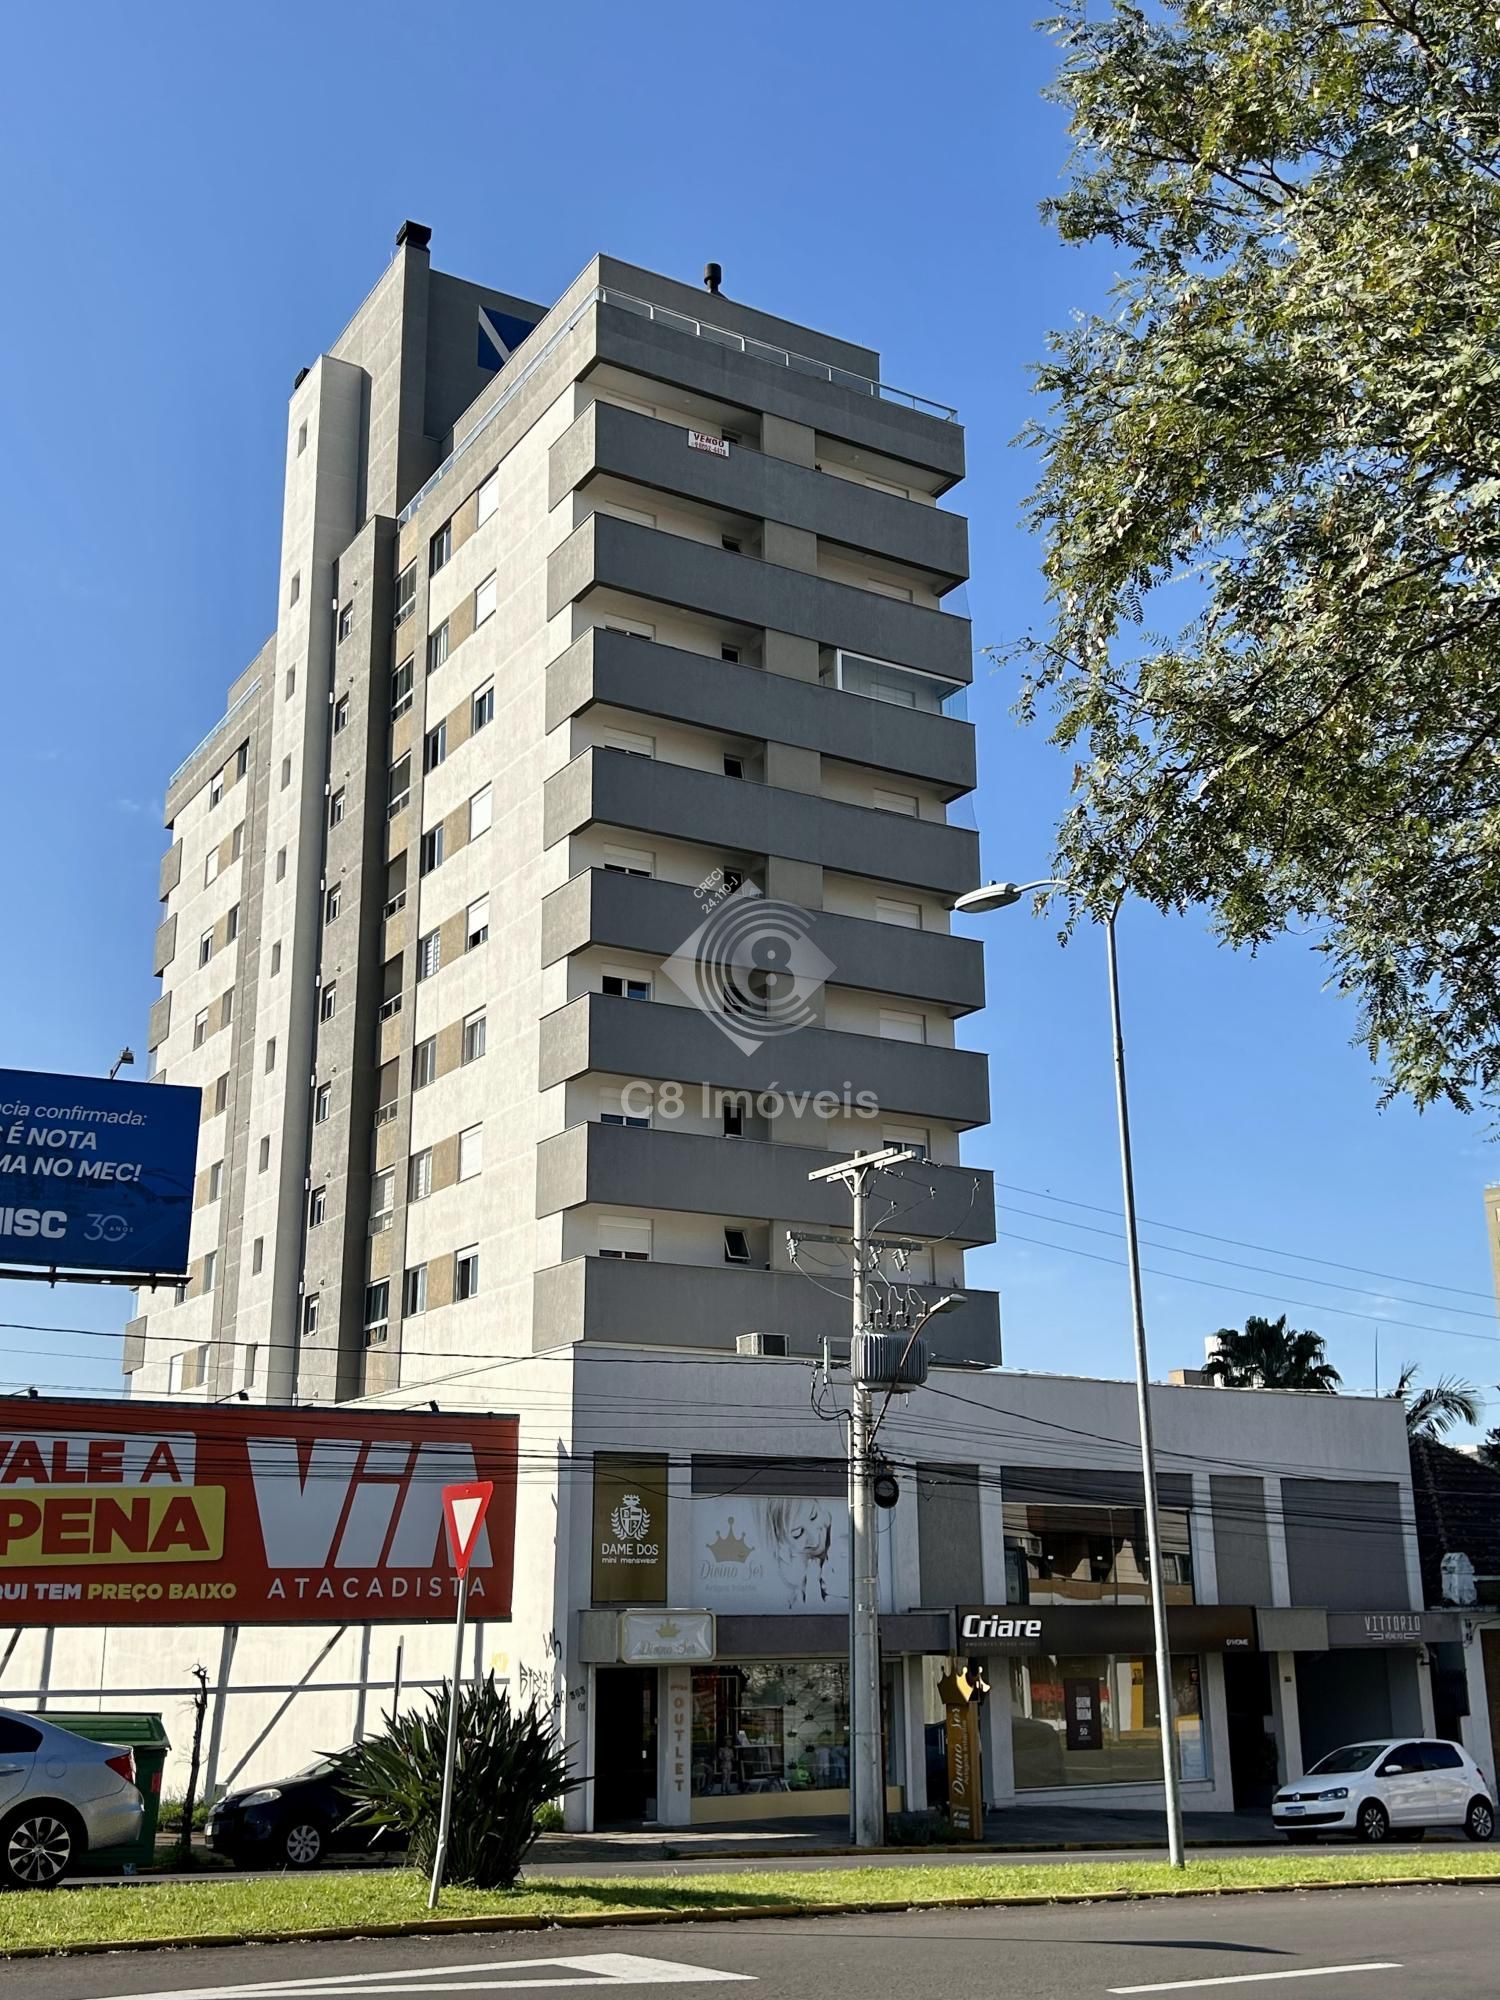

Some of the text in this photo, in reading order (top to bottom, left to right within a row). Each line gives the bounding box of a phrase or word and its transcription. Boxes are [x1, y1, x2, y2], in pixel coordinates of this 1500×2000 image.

[693, 432, 725, 447] VENDO
[0, 1100, 147, 1126] cia confirmada:
[7, 1120, 97, 1150] É NOTA
[32, 1157, 73, 1177] NO
[77, 1160, 142, 1182] MEC!
[0, 1207, 68, 1239] ISC
[140, 1440, 182, 1483] A
[0, 1496, 211, 1556] PENA
[601, 1543, 659, 1555] DAME DOS
[601, 1556, 659, 1565] mini menswear
[0, 1583, 237, 1604] UI TEM PREÇO BAIXO
[267, 1576, 486, 1599] ATACADISTA
[962, 1614, 1041, 1637] Criare
[1364, 1615, 1420, 1631] VITTORIO
[673, 1696, 685, 1792] OUTLET
